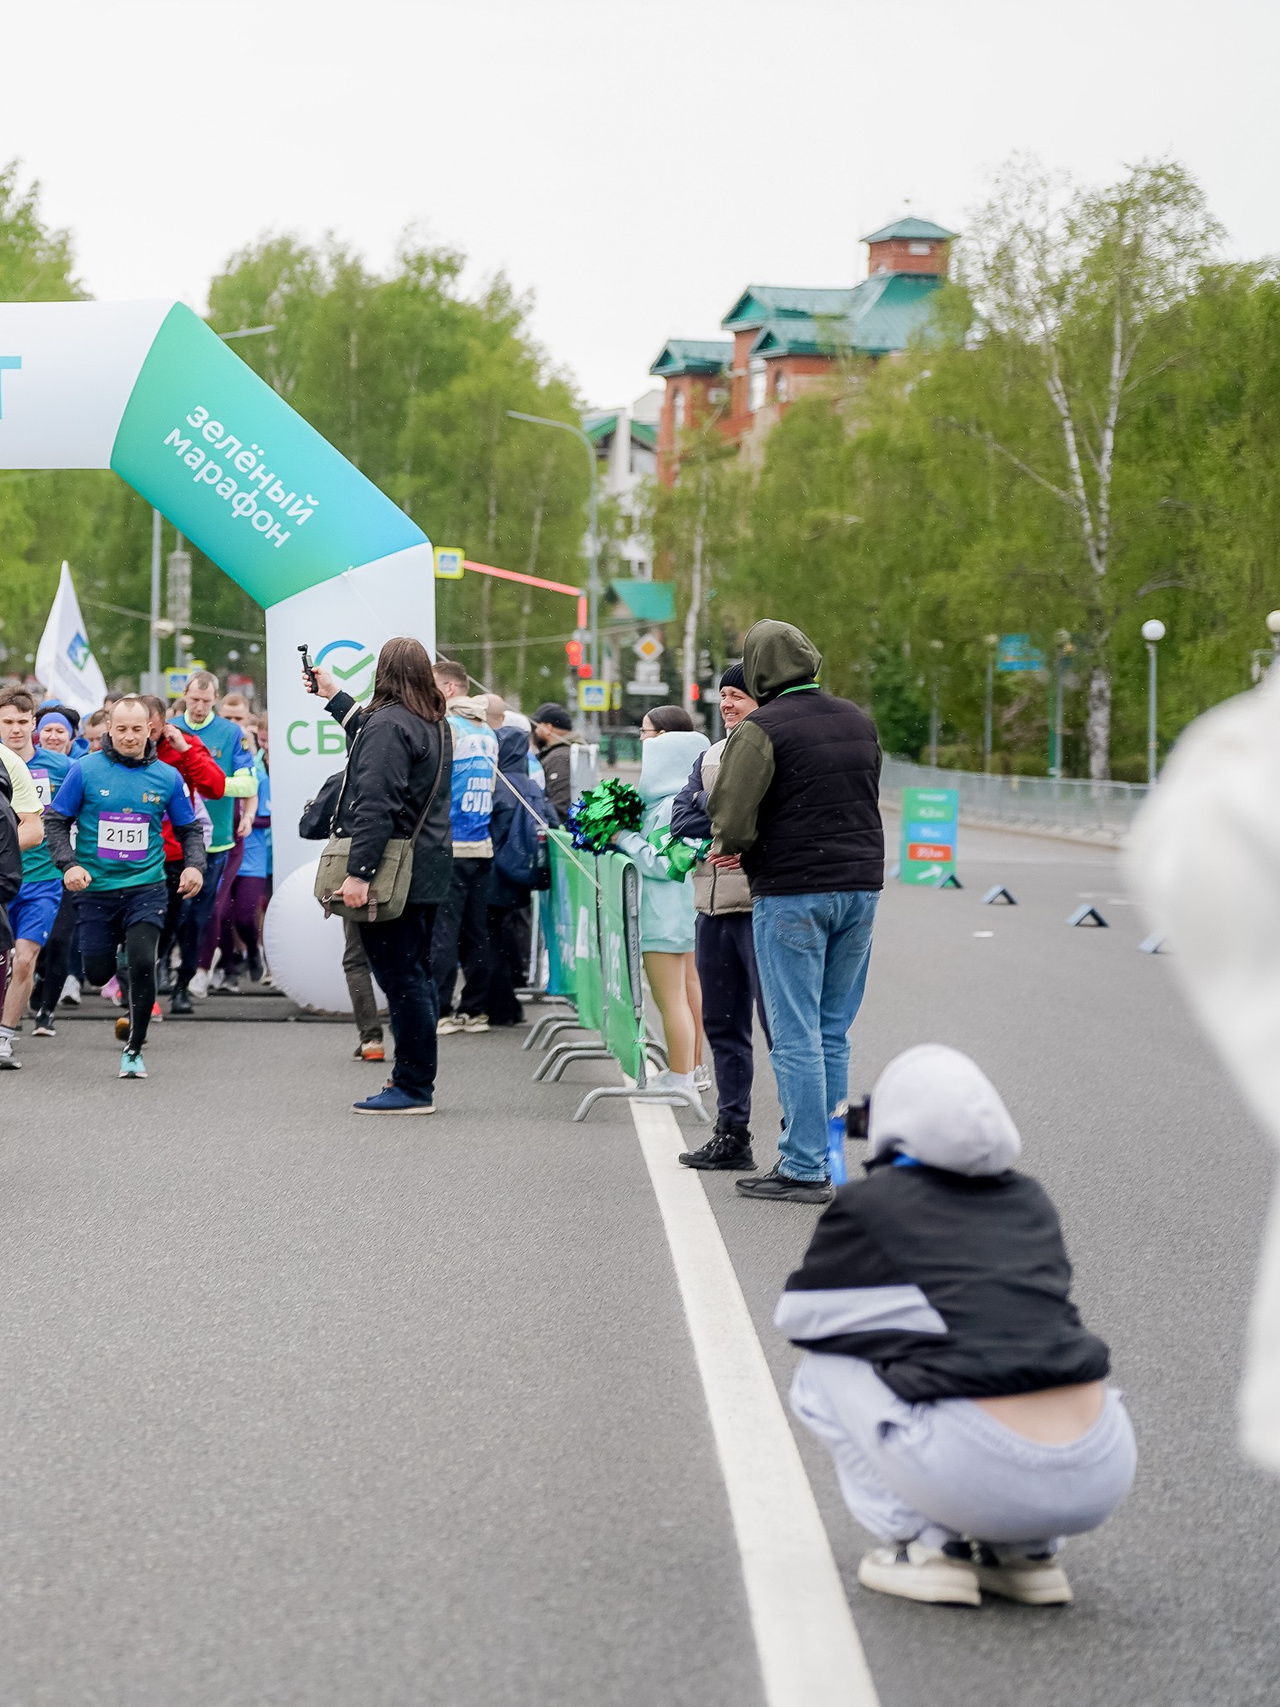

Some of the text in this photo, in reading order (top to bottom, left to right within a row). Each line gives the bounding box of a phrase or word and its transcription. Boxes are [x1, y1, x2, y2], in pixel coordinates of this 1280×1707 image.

[186, 405, 319, 526] зелёный
[163, 427, 291, 548] марафон
[286, 720, 347, 756] СБ
[461, 791, 494, 816] СУД
[106, 828, 143, 844] 2151
